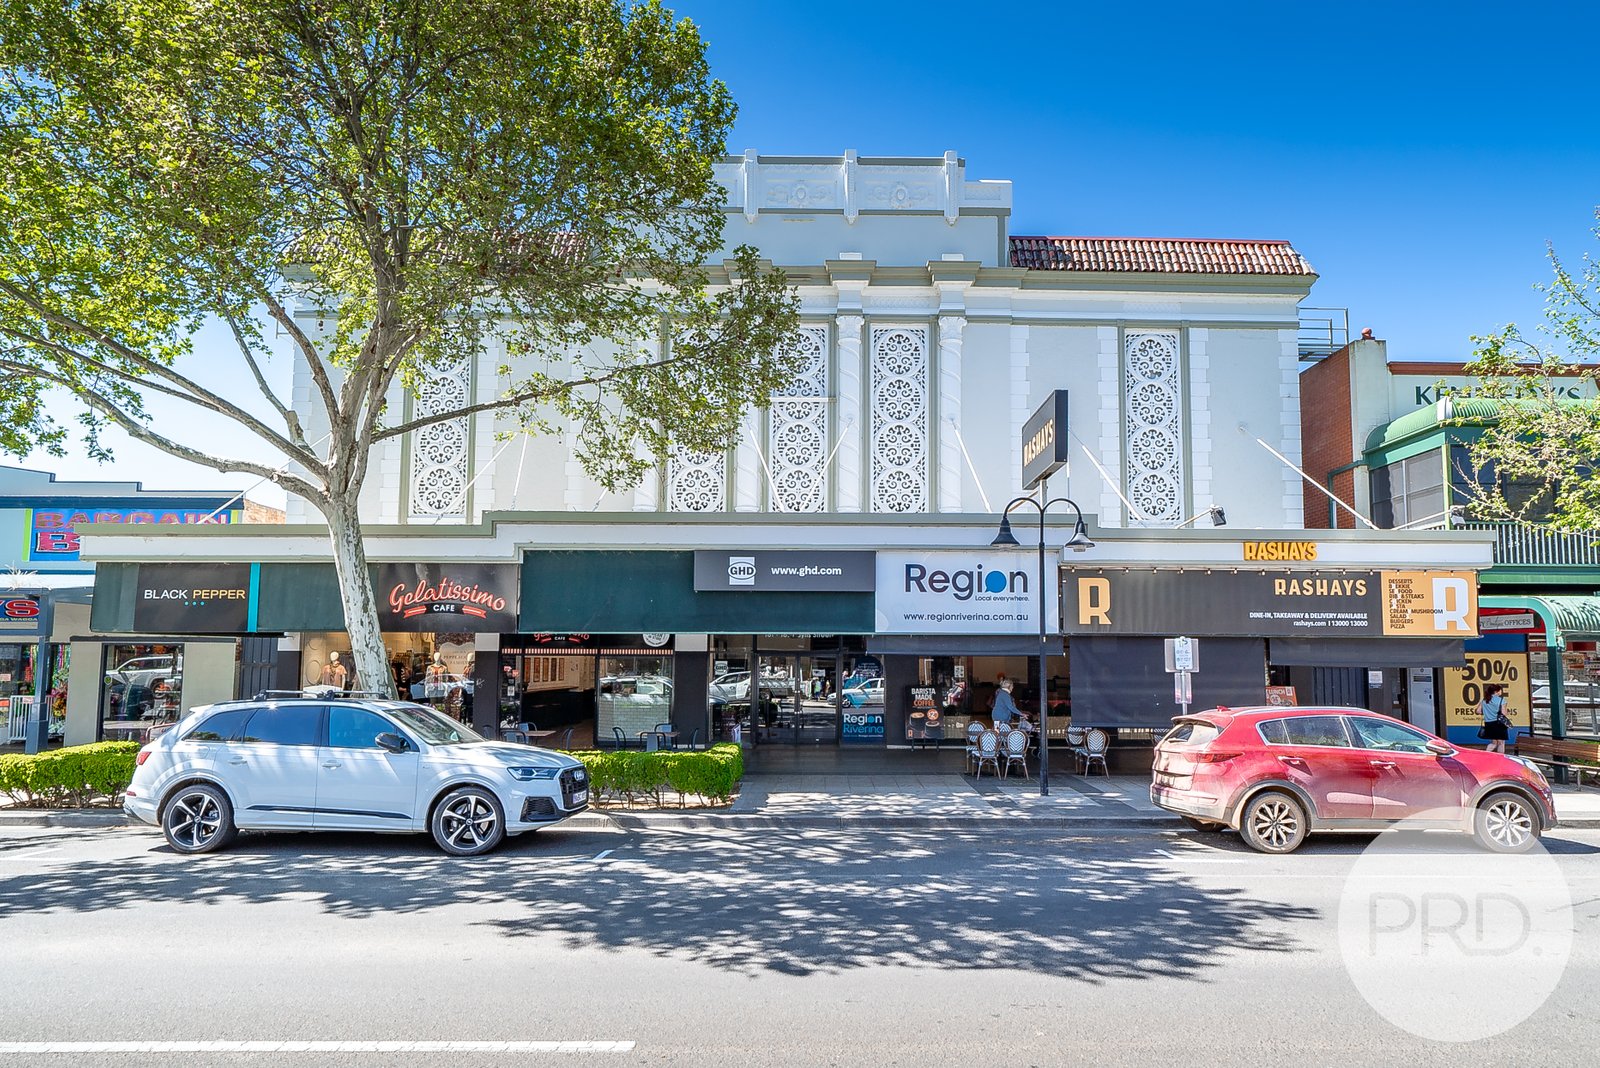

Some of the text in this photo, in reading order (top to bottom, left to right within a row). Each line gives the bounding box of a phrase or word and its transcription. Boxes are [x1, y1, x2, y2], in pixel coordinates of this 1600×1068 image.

[1024, 419, 1053, 467] RASHAYS
[1243, 541, 1318, 561] RASHAYS
[730, 566, 753, 576] GHD
[771, 566, 842, 577] www.ghd.com
[904, 563, 1028, 601] Region
[1274, 579, 1367, 596] RASHAYS
[144, 590, 246, 600] BLACK PEPPER
[389, 577, 506, 613] Gelatissimo
[1078, 577, 1112, 625] R
[433, 604, 455, 612] CAFE
[1432, 577, 1471, 631] R
[903, 612, 1029, 622] www.regionriverina.com.au
[1461, 658, 1518, 681] 50%
[843, 713, 882, 725] Region
[843, 724, 884, 734] Riverina
